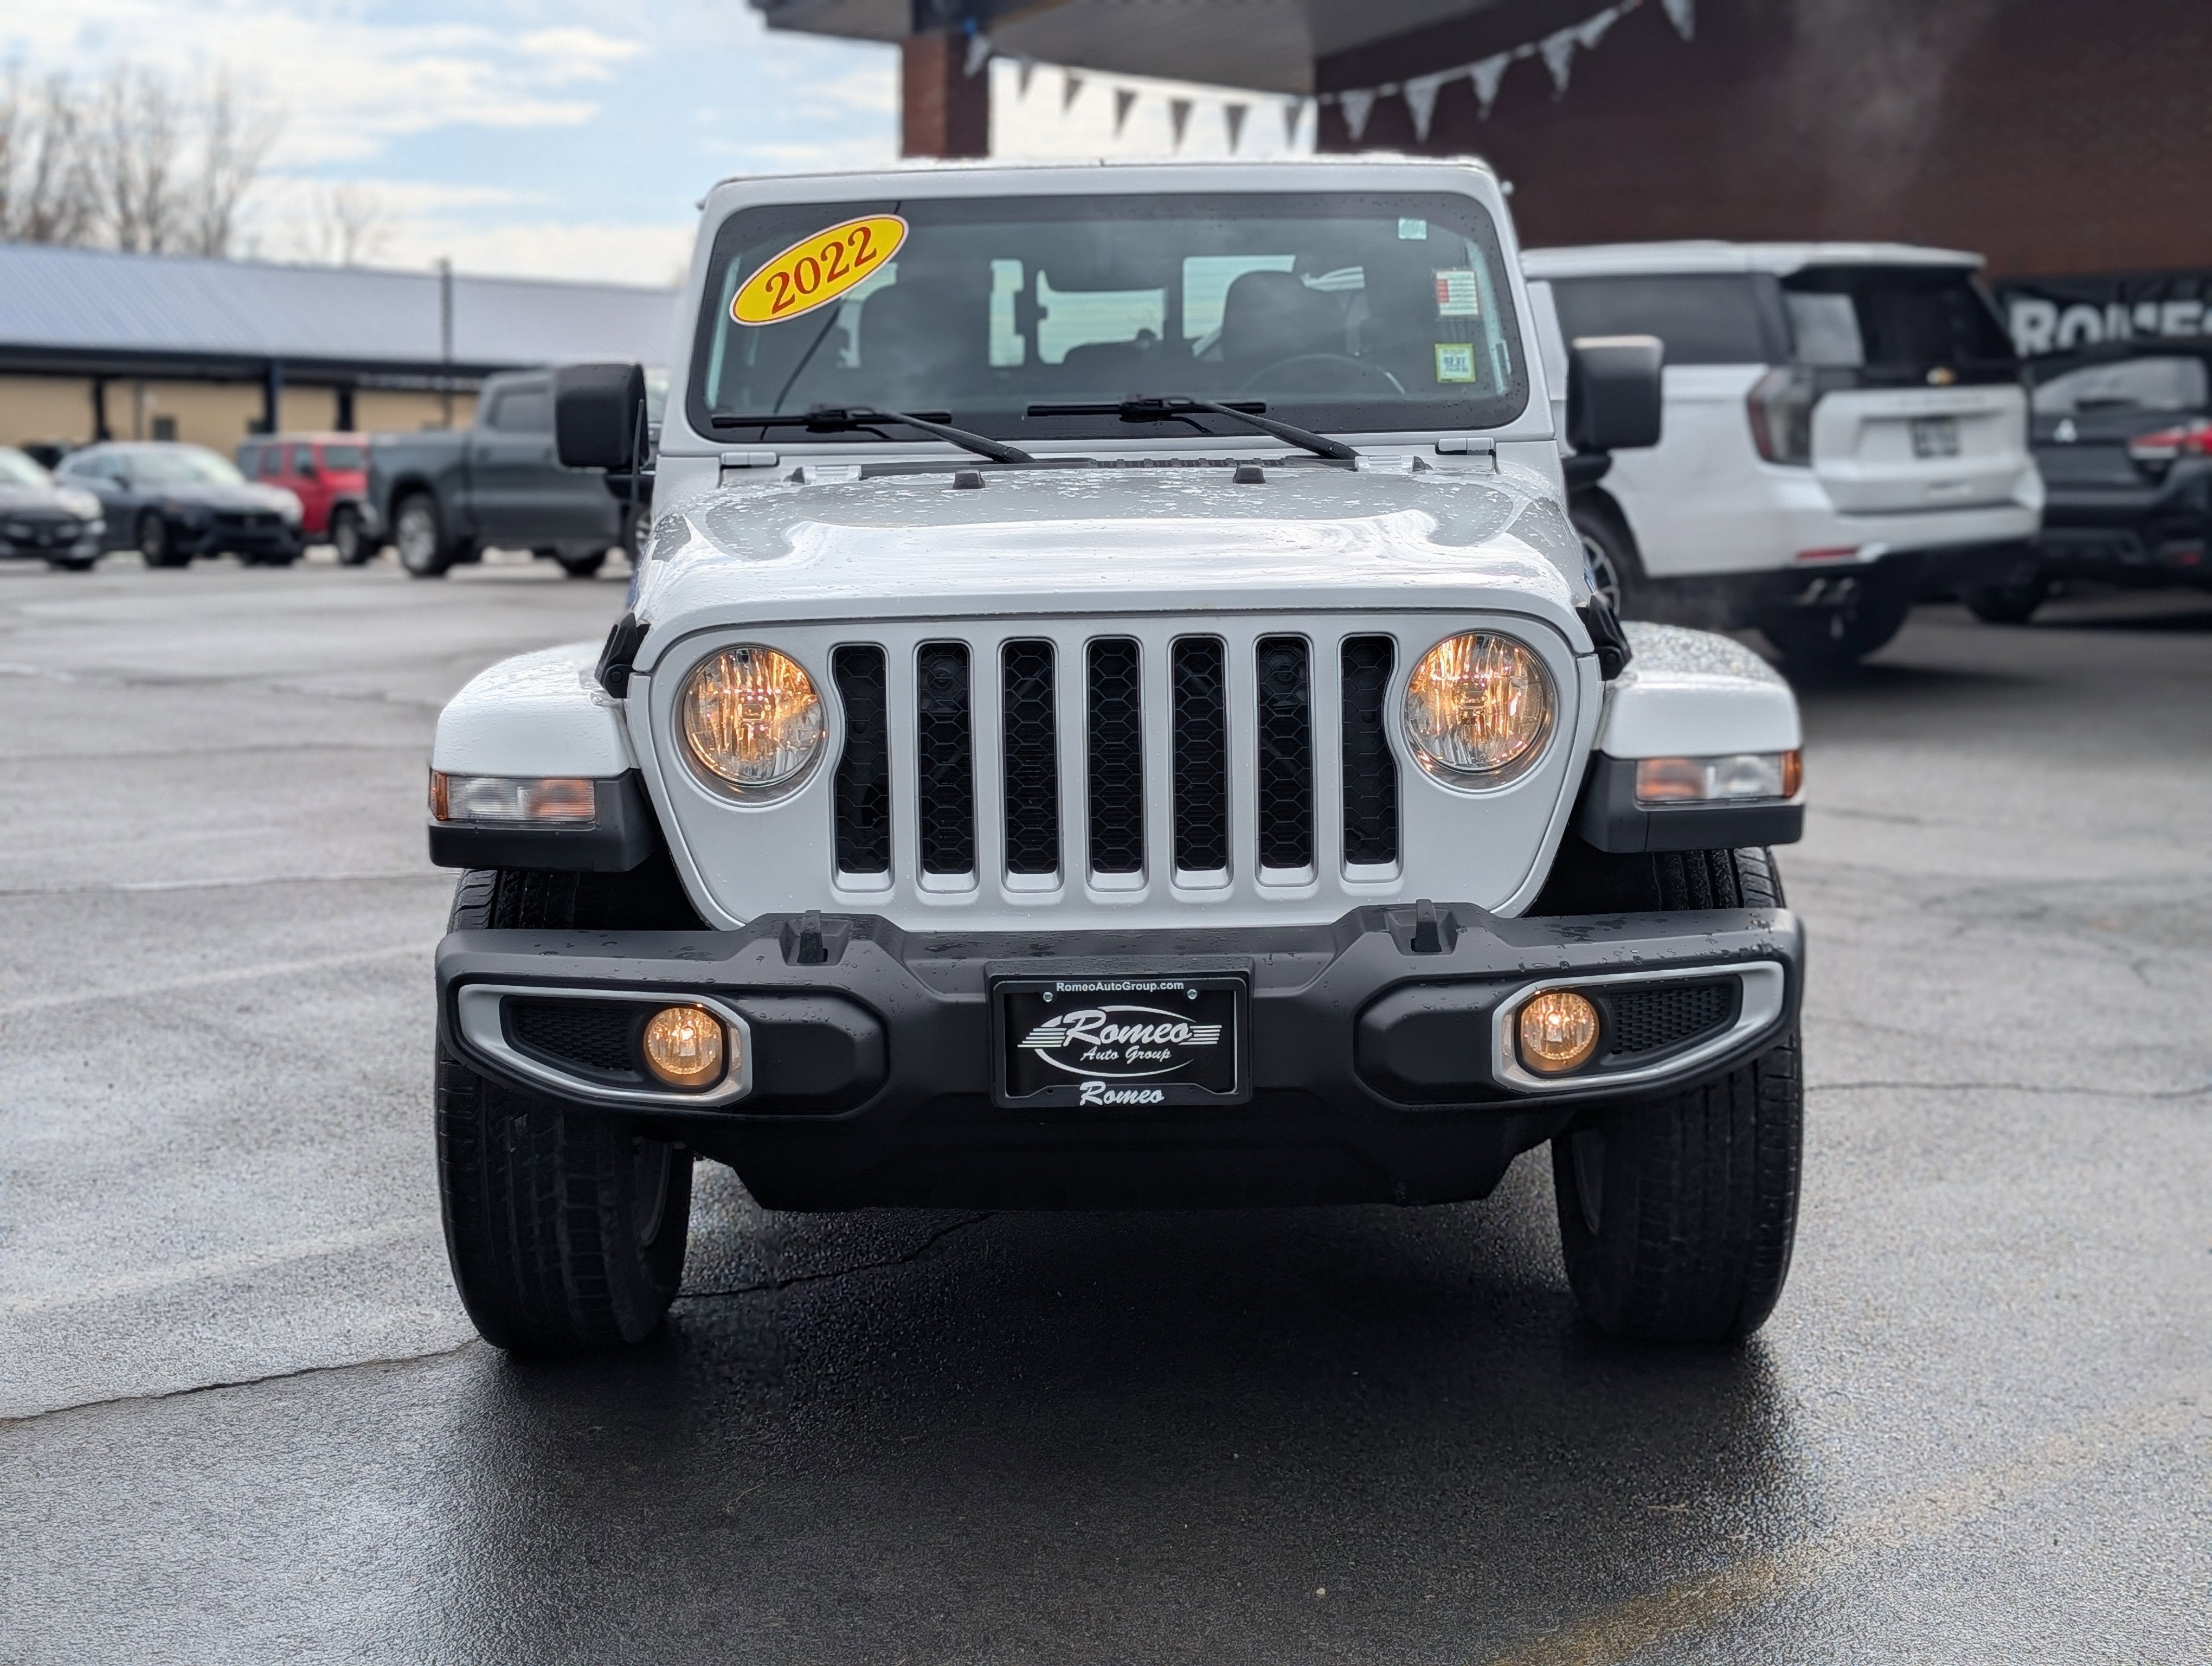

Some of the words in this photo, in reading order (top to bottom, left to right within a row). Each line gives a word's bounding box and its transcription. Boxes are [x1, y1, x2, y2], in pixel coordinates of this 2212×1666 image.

[765, 226, 877, 315] 2022
[1056, 981, 1184, 992] RomeoAutoGroup.com
[1063, 1009, 1193, 1046] Romeo
[1080, 1046, 1120, 1061] Auto
[1125, 1045, 1172, 1065] Group
[1079, 1081, 1165, 1106] Romeo
